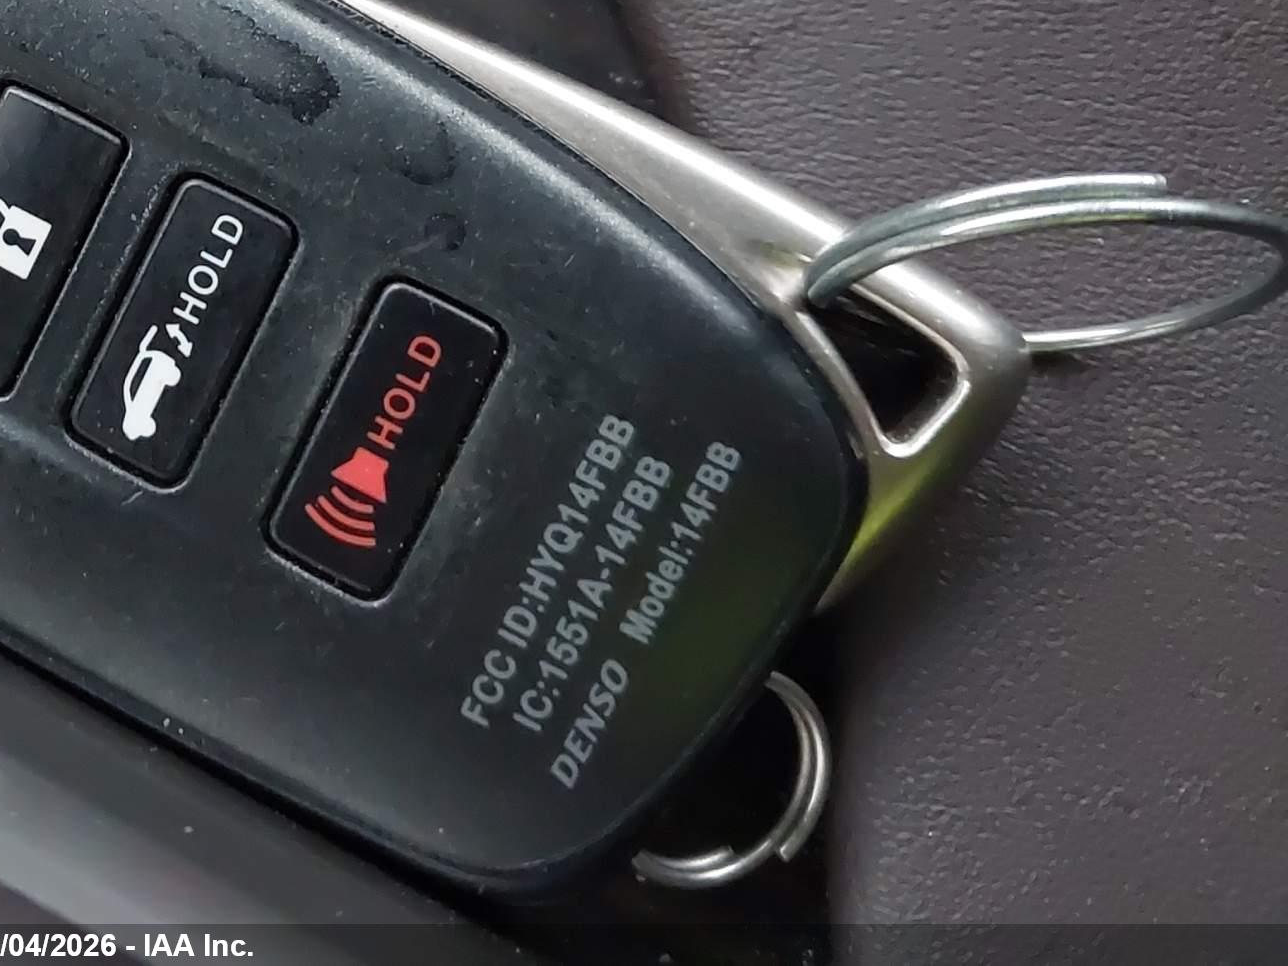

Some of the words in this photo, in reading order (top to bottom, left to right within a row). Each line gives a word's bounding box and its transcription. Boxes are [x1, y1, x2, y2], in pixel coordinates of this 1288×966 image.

[173, 214, 244, 325] HOLD
[367, 335, 442, 449] HOLD
[460, 649, 517, 727] FCC
[498, 414, 634, 648] ID:HYQ14FBB
[513, 456, 671, 731] IC:1551A-14FBB
[550, 659, 629, 789] DENSO
[619, 441, 742, 645] Model:14FBB
